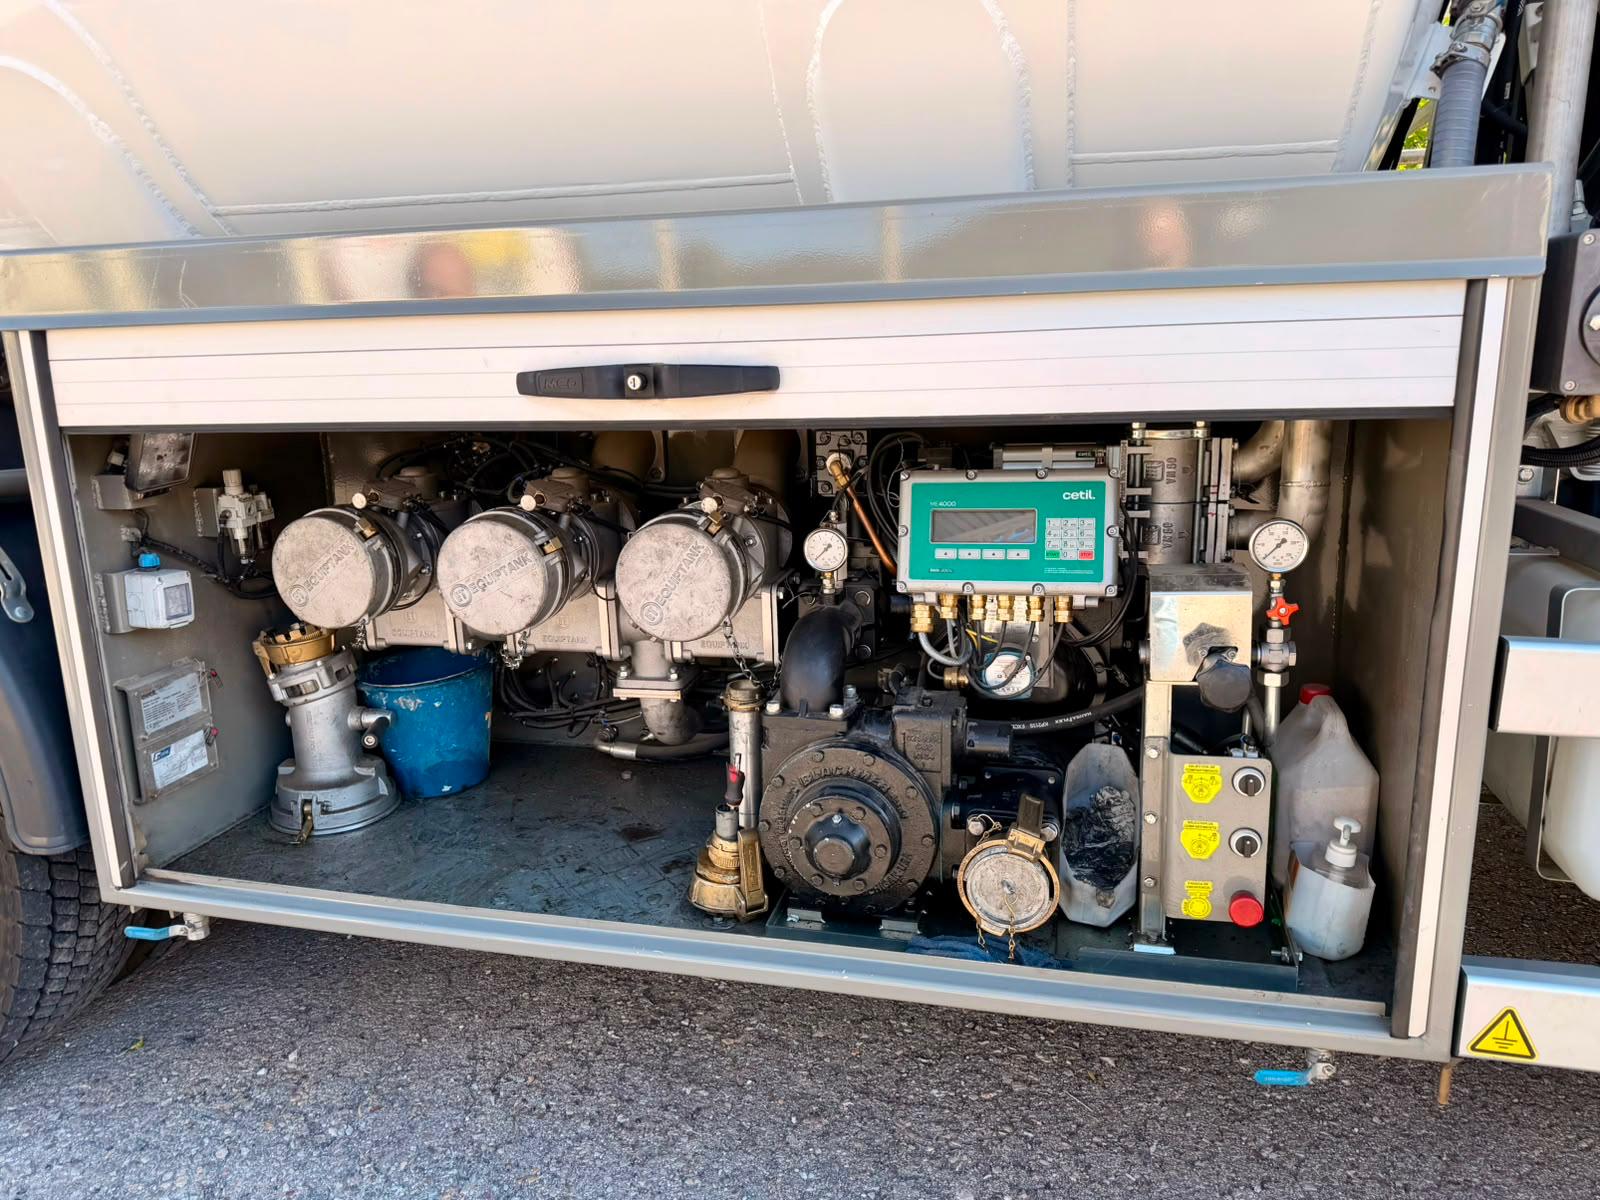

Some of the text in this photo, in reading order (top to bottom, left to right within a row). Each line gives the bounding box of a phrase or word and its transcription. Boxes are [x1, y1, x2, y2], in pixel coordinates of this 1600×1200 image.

[304, 541, 356, 592] EQUIPTANK
[470, 552, 532, 595] EQUIPTANK
[657, 544, 703, 606] EQUIPTANK
